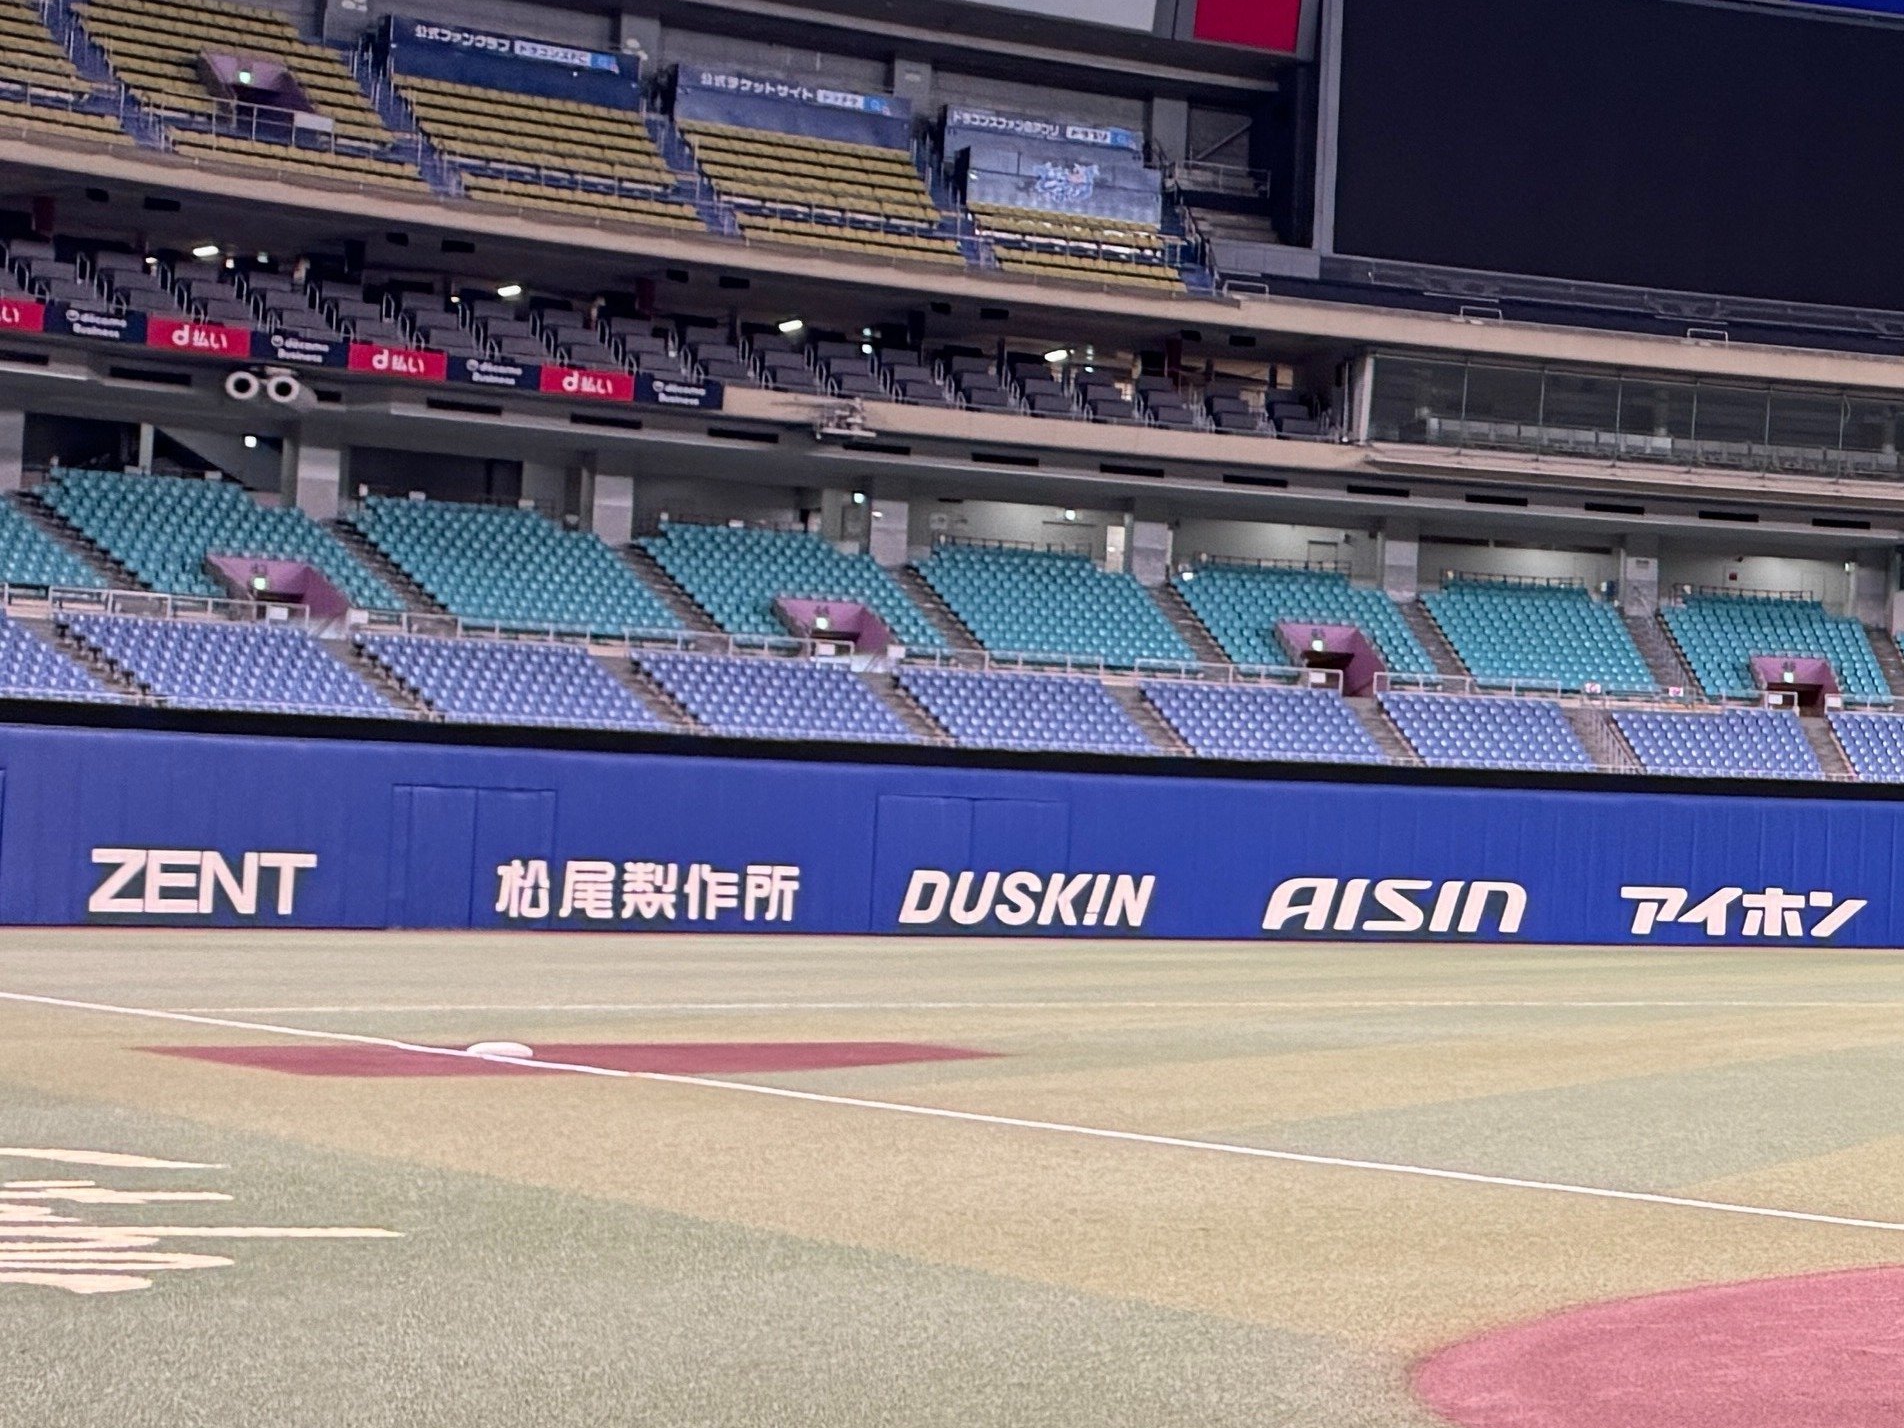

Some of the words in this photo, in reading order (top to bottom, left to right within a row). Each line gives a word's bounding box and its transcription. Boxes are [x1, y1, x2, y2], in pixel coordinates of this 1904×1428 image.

[88, 848, 317, 915] ZENT
[496, 859, 800, 922] 松尾製作所
[1261, 877, 1528, 933] AISIN
[1620, 886, 1867, 937] アイホン
